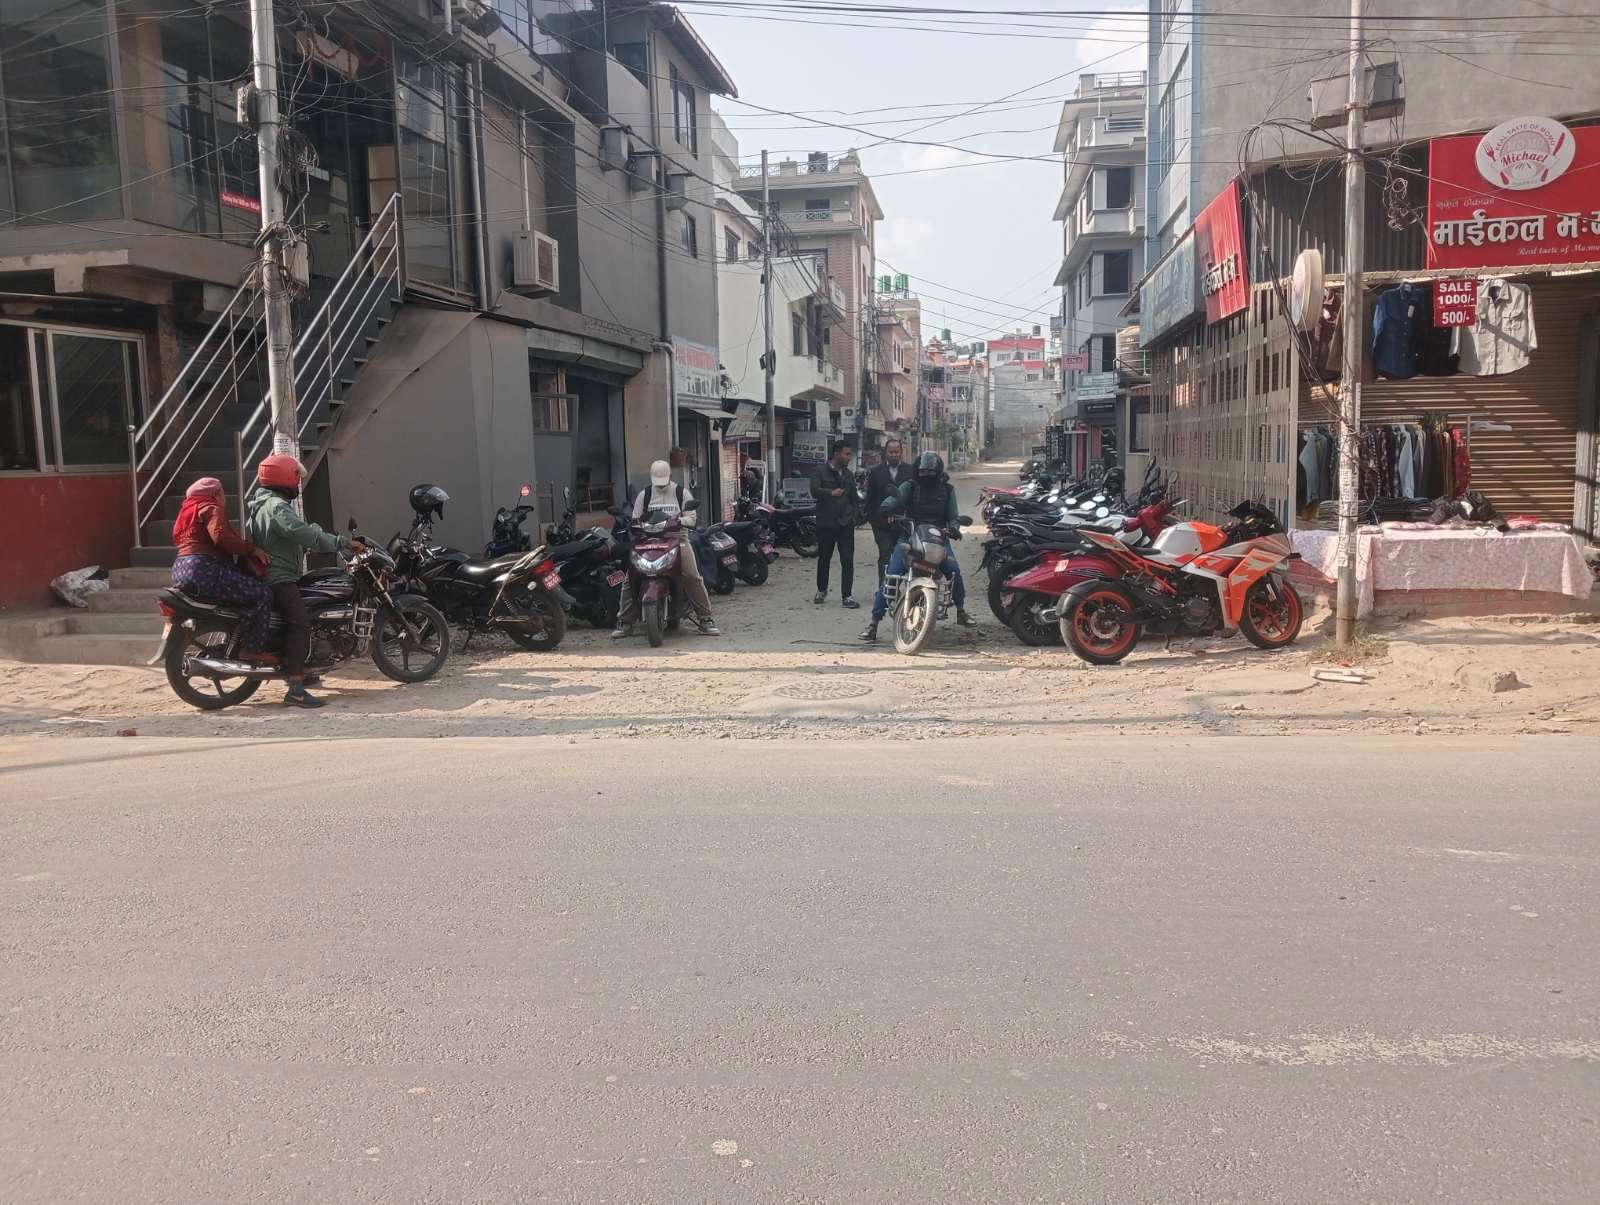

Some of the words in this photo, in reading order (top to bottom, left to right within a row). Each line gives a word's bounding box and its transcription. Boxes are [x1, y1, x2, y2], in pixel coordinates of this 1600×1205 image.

[1501, 151, 1548, 166] Michael
[1433, 209, 1547, 246] माईकल
[1560, 245, 1570, 255] of
[1439, 281, 1472, 292] SALE
[1438, 294, 1475, 304] 1000/-
[1441, 311, 1470, 324] 500/-
